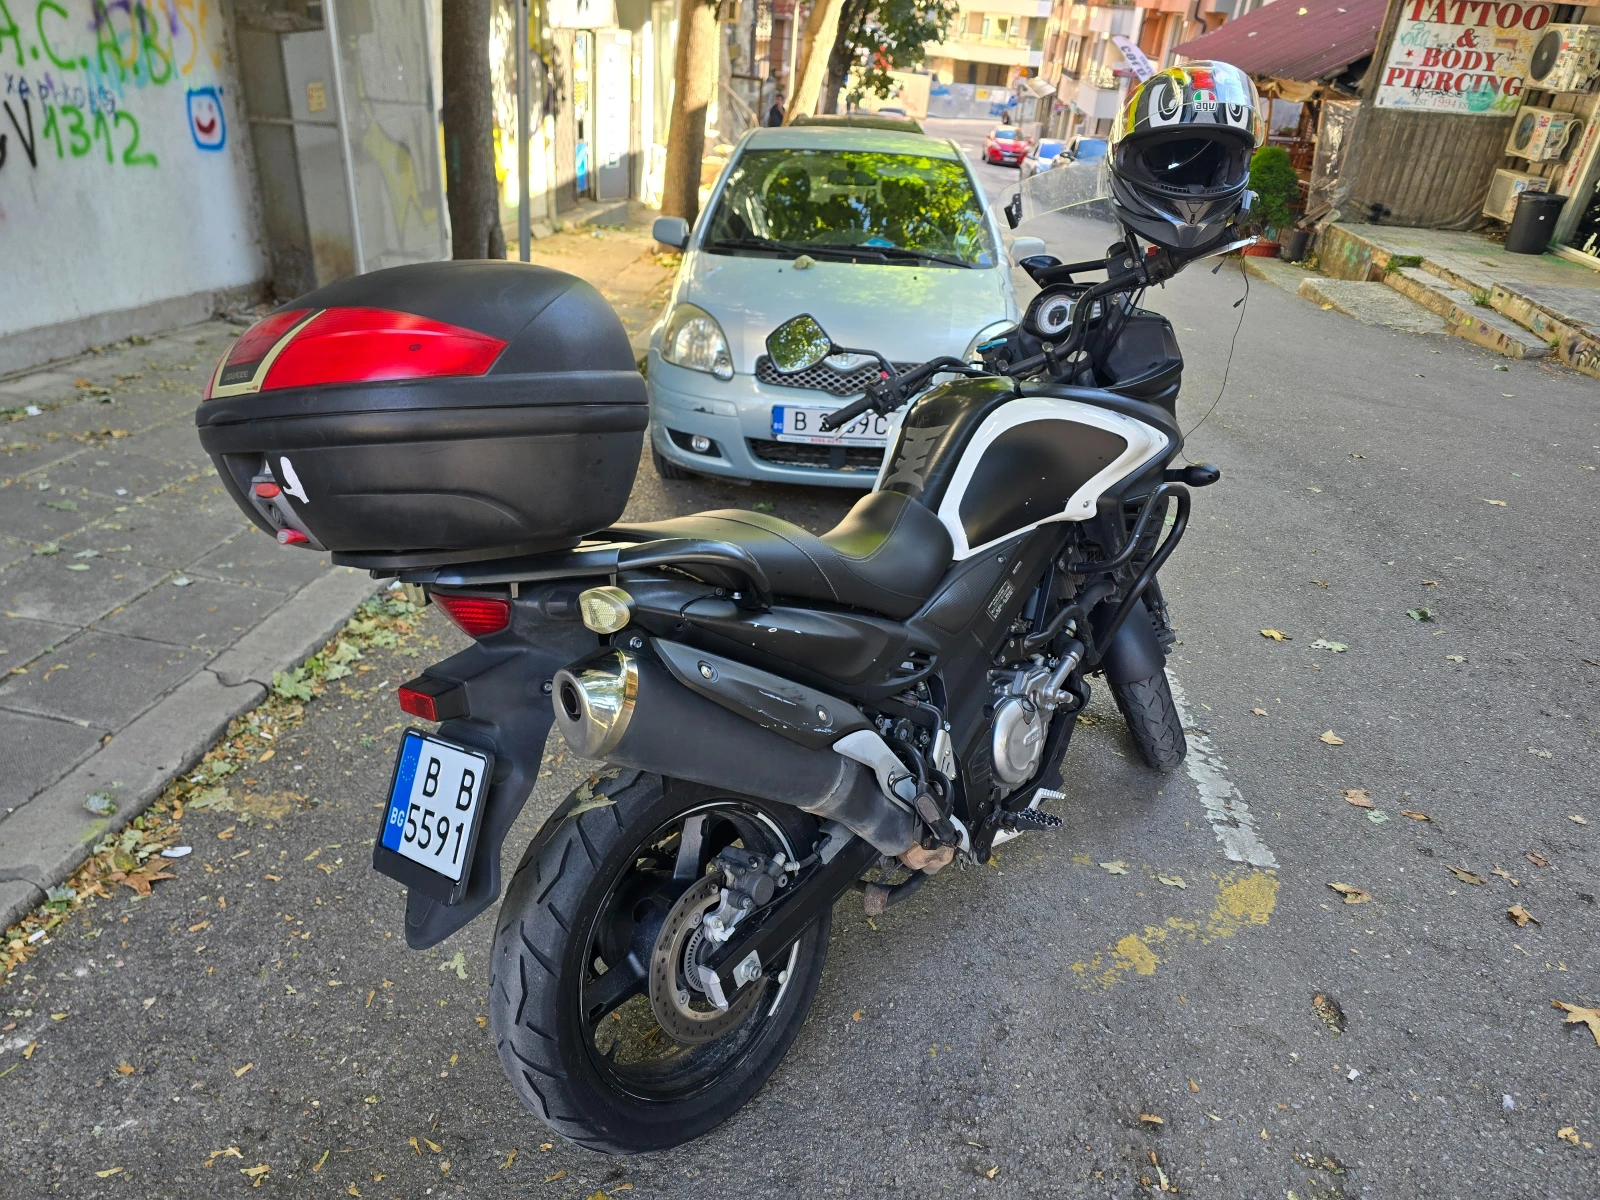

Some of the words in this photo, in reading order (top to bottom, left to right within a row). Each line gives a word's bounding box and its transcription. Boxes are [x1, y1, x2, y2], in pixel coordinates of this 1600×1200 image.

[1406, 0, 1550, 31] TATTOO
[1456, 28, 1479, 49] &
[1419, 47, 1503, 72] BODY
[1381, 67, 1524, 96] PIERCING
[1195, 102, 1216, 112] agv
[1431, 97, 1457, 108] 1994
[44, 104, 158, 167] 1312
[422, 756, 441, 798] B
[456, 768, 475, 811] B
[390, 806, 405, 827] BG
[404, 802, 465, 865] 5591
